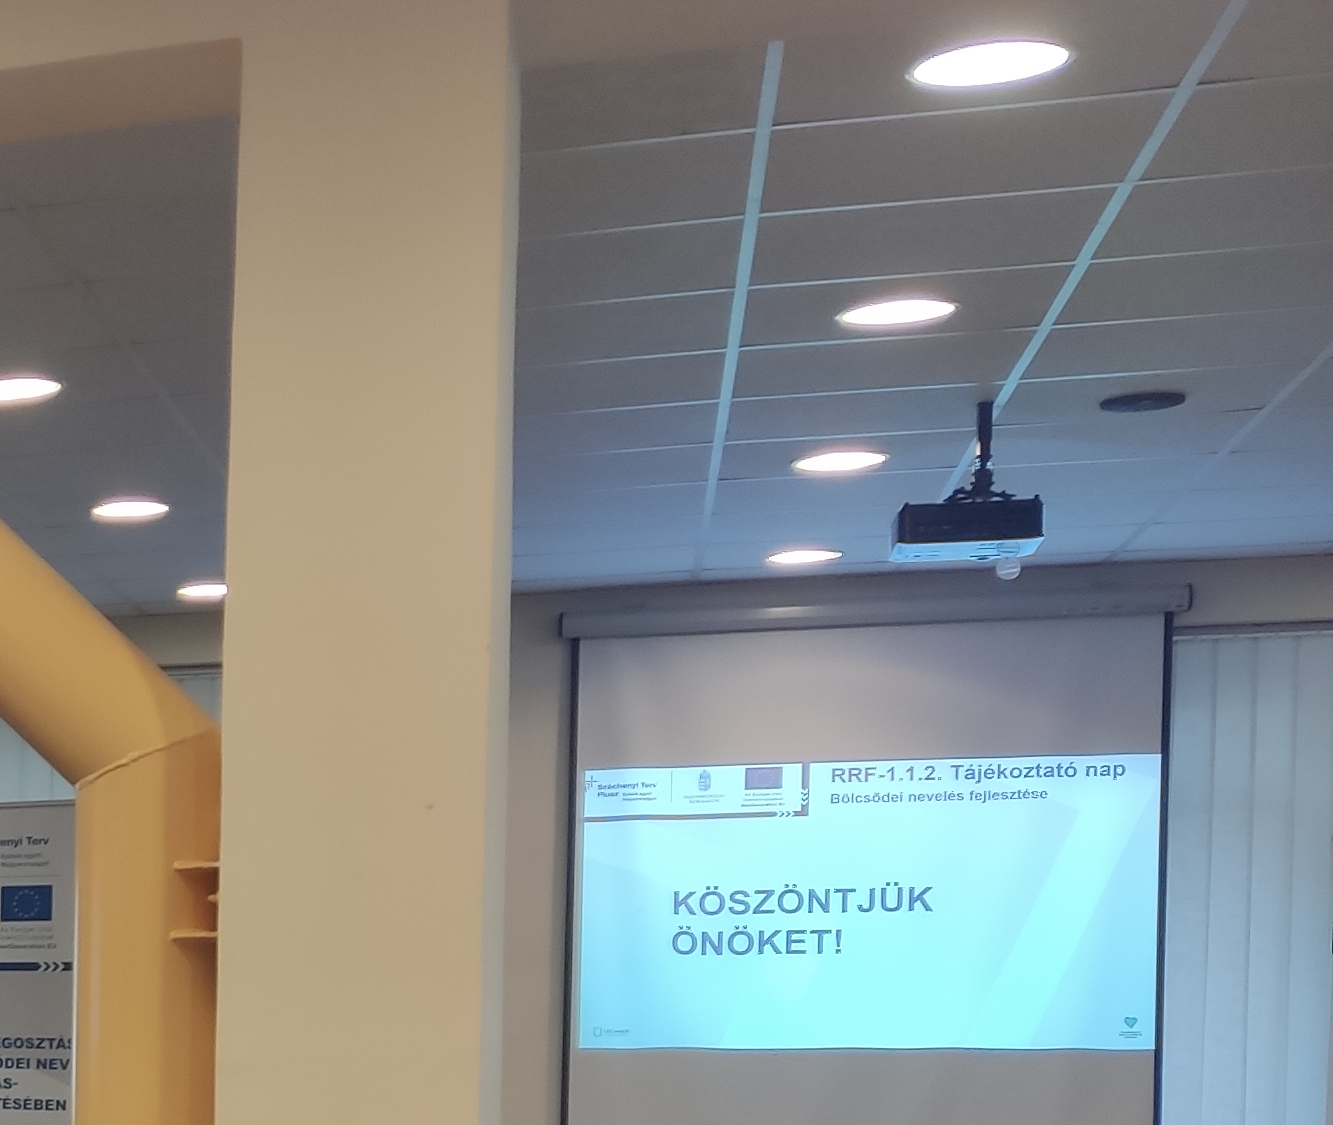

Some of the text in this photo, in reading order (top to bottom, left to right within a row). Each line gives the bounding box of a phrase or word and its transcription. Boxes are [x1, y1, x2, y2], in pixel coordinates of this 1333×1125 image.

[831, 762, 1126, 784] RRF-1.1.2. Tájékoztató nap
[830, 788, 1048, 804] Bölcsődei nevelés fejlesztése
[673, 881, 934, 916] KÖSZÖNTJÜK
[671, 924, 842, 956] ÖNÖKET!
